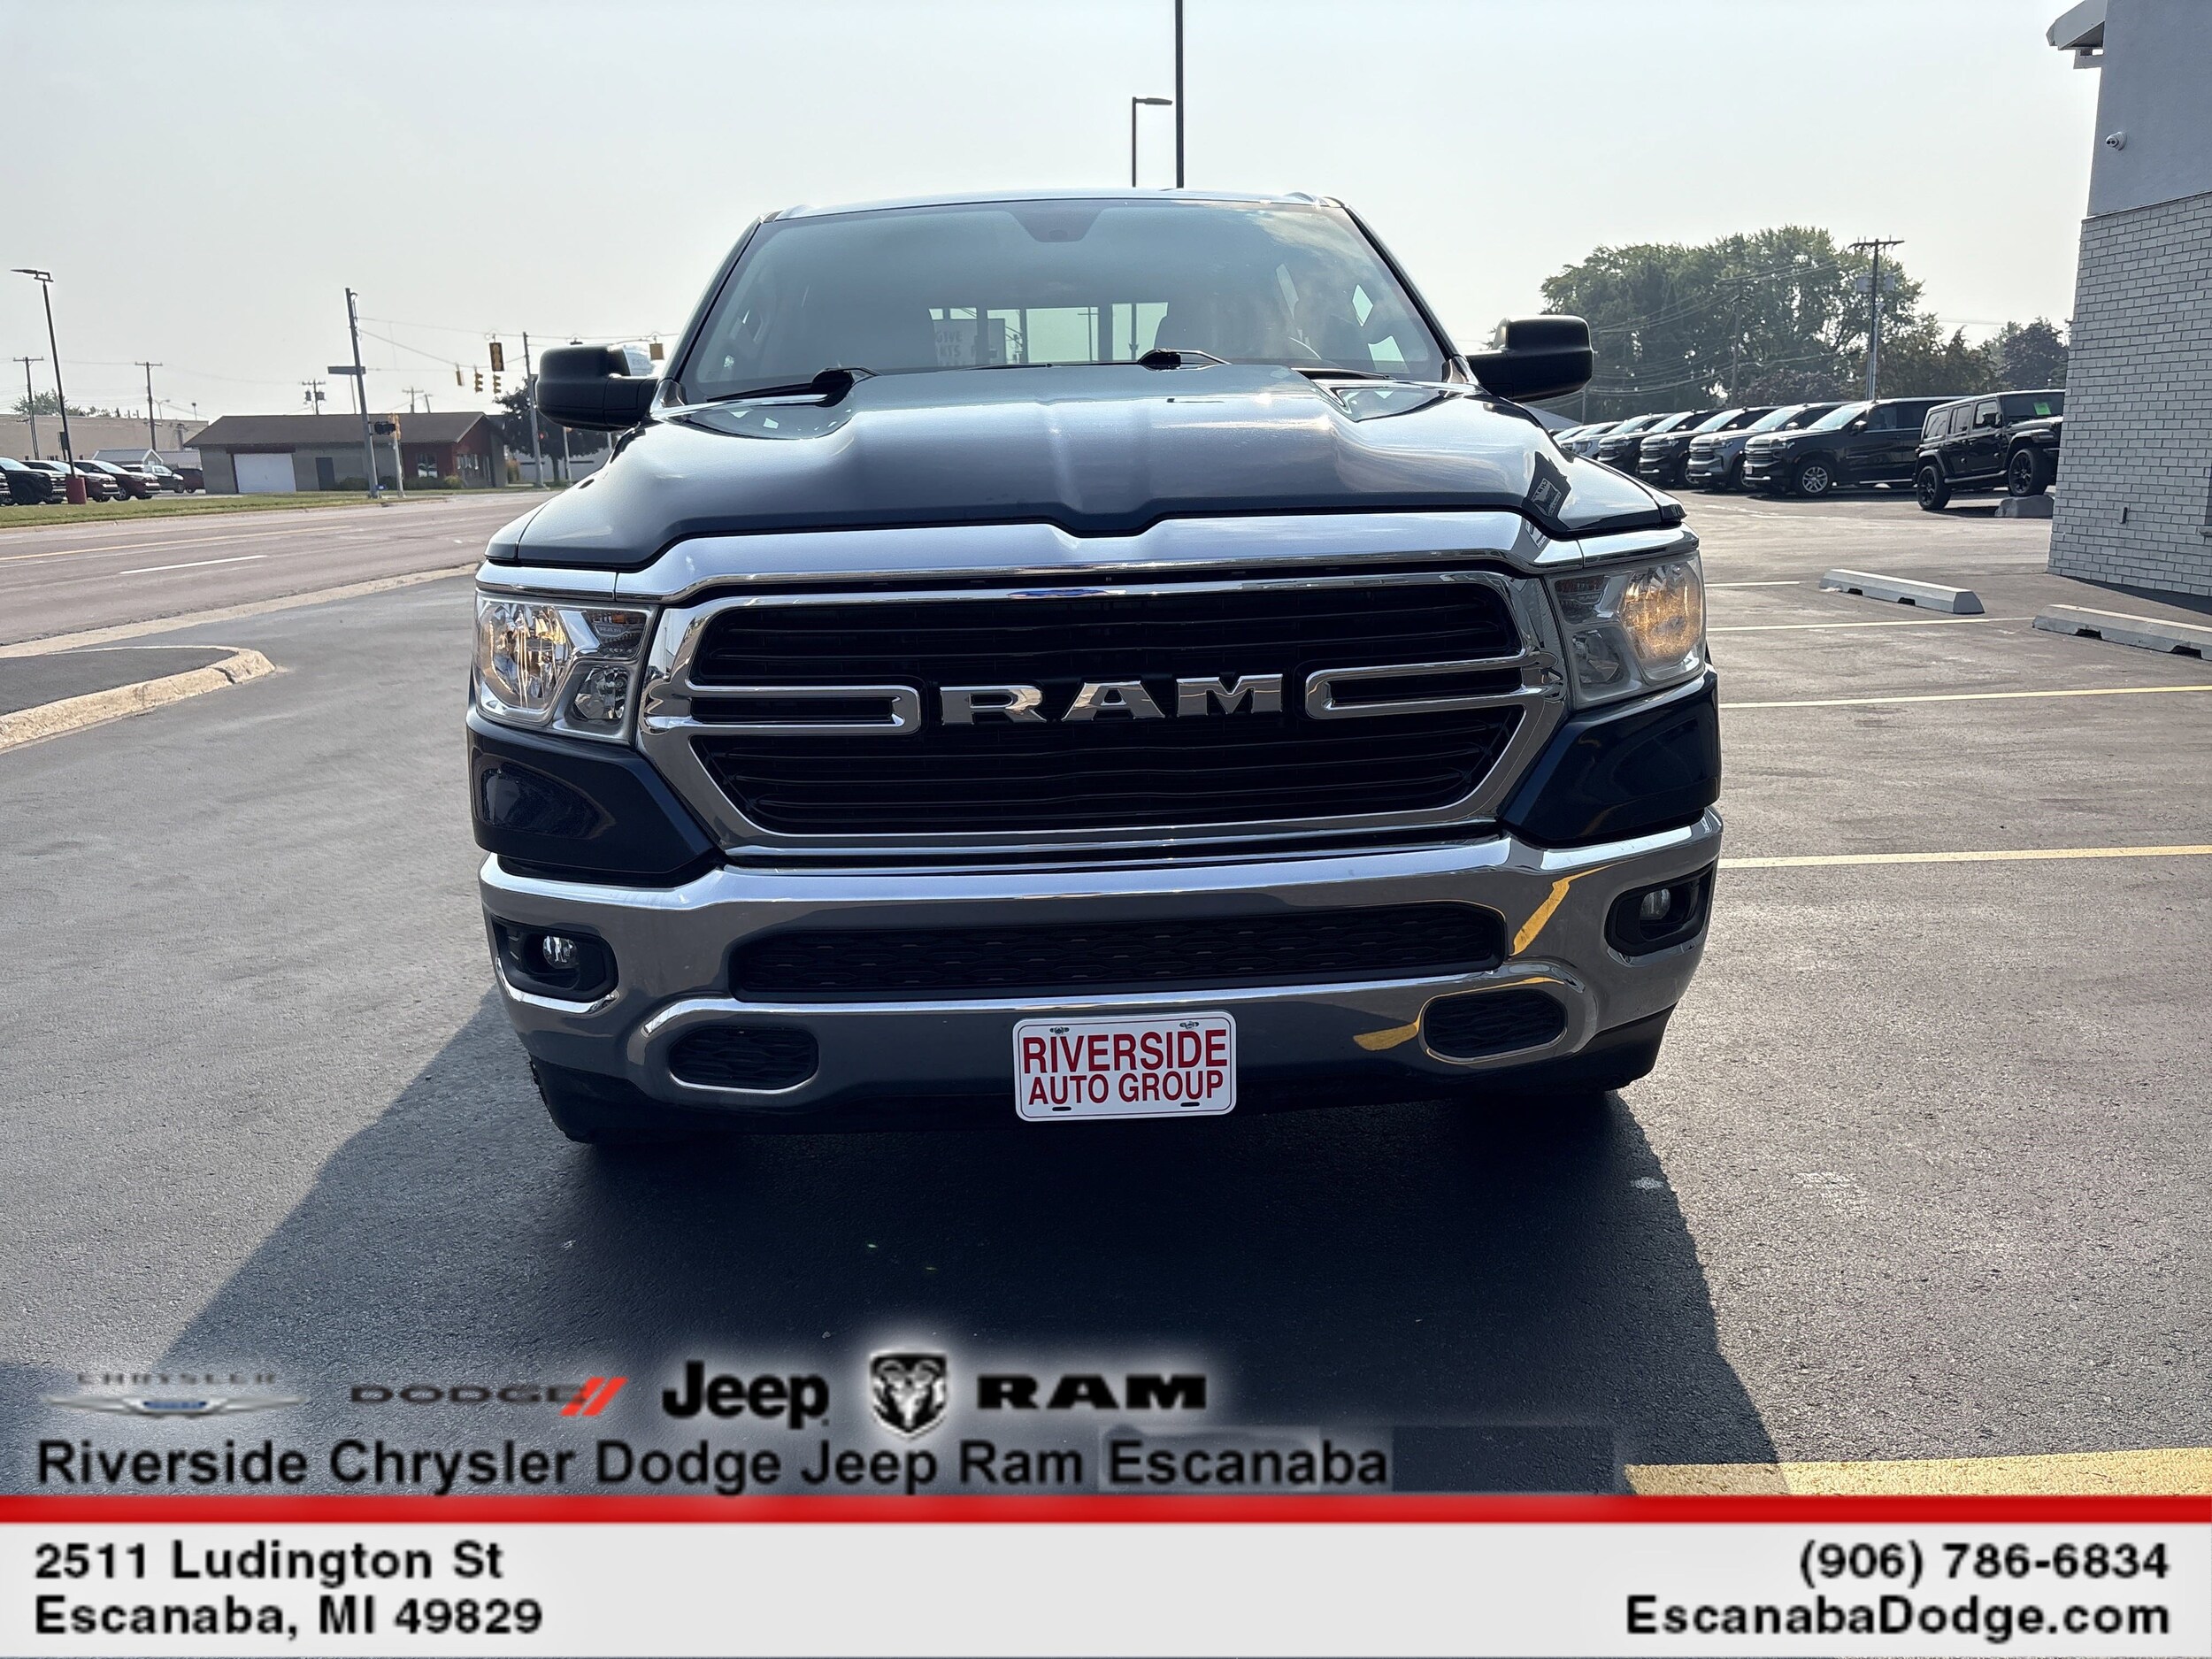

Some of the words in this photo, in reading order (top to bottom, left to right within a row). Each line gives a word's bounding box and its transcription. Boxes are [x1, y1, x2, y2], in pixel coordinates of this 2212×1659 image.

[940, 673, 1283, 726] RAM
[1023, 1029, 1228, 1074] RIVERSIDE
[1028, 1073, 1110, 1105] AUTO
[1118, 1070, 1224, 1103] GROUP
